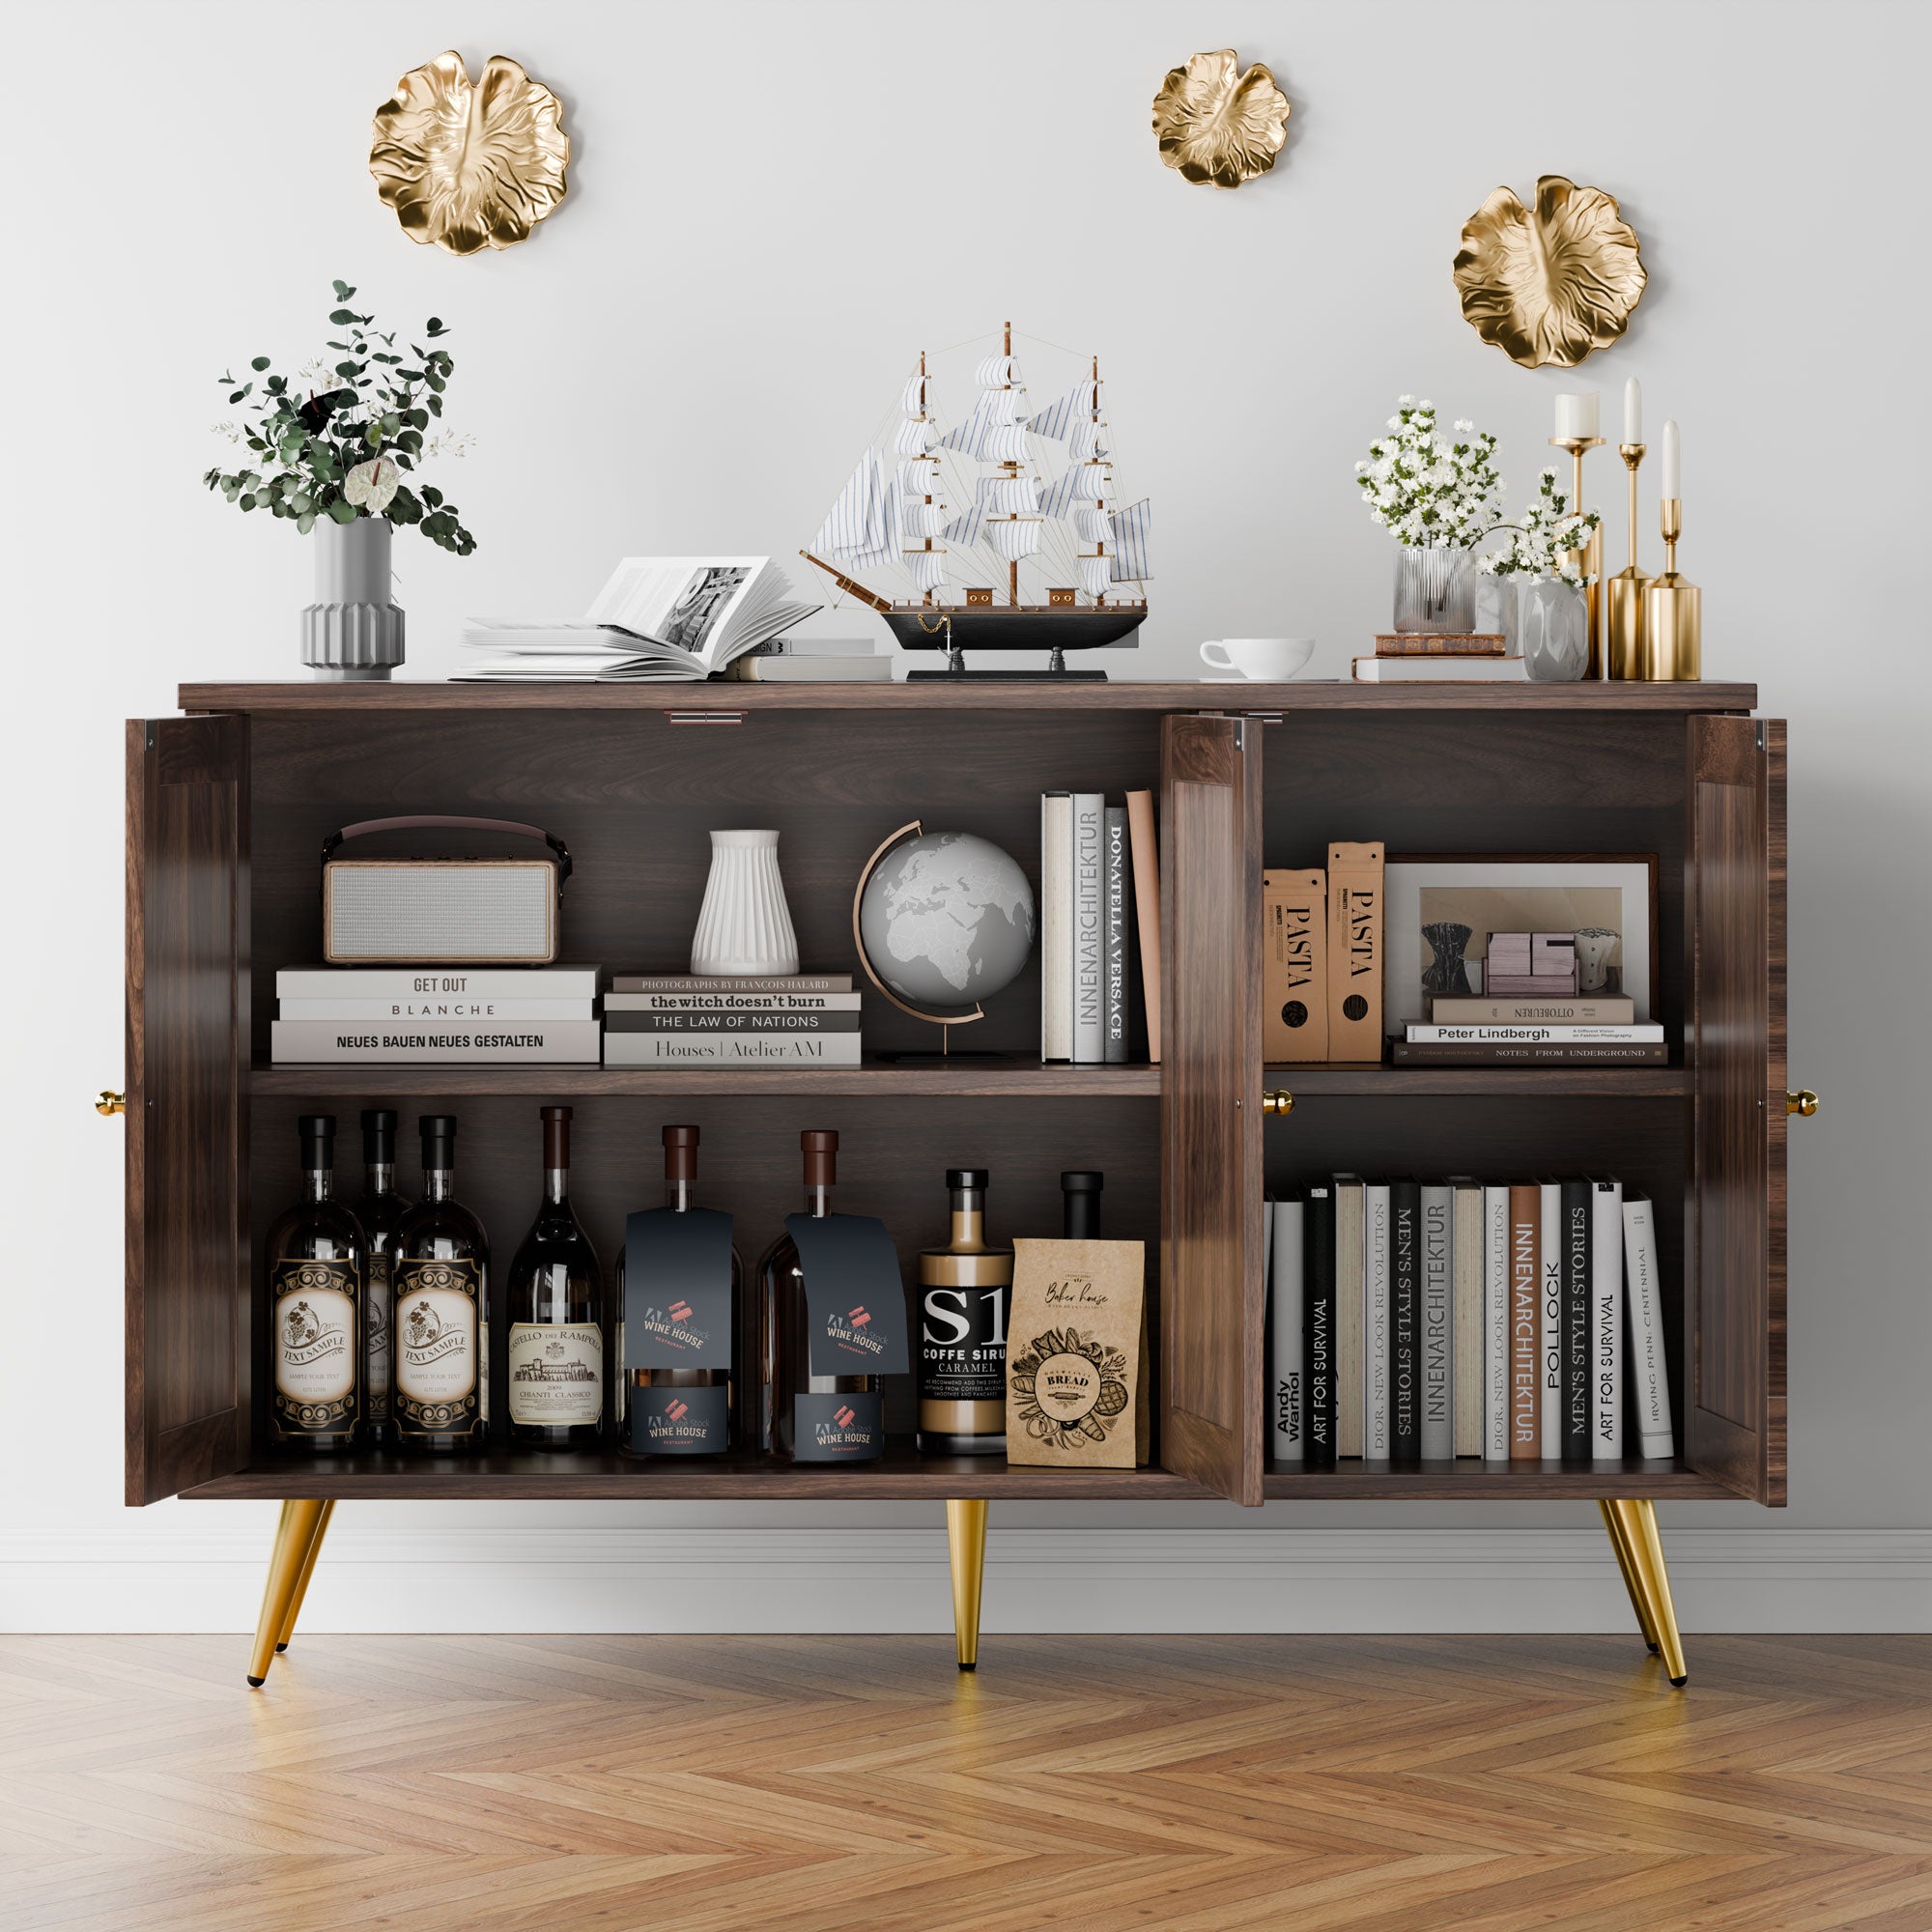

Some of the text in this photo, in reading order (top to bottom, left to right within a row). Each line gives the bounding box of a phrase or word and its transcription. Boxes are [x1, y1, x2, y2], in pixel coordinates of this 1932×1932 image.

[1080, 811, 1097, 1025] INNENARCHITEKTUR
[1111, 826, 1122, 1039] DONATELLA VERSACE
[1351, 891, 1374, 978] PASTA
[1287, 906, 1313, 990] PASTA
[413, 978, 468, 992] GET OUT
[641, 980, 829, 991] PHOTOGRAPHS BY FRANÇOIS HALARD
[651, 996, 676, 1008] the
[679, 996, 723, 1008] witch
[787, 996, 825, 1008] burn
[392, 1005, 495, 1015] BLANCHE
[653, 1016, 819, 1027] THE LAW OF NATIONS
[1515, 1008, 1575, 1018] OTTOBEUREN
[337, 1036, 543, 1048] NEUES BAUEN NEUES GESTALTEN
[657, 1041, 715, 1057] Houses
[728, 1041, 786, 1057] Atelier
[788, 1041, 822, 1057] AM
[1438, 1028, 1549, 1041] Peter Lindbergh
[1494, 1204, 1503, 1308] REVOLUTION
[1573, 1208, 1584, 1294] STORIES
[1638, 1246, 1652, 1327] CENTENNIAL
[1399, 1278, 1412, 1343] STYLE
[1428, 1206, 1445, 1422] INNENARCHITEKTUR
[1547, 1262, 1559, 1388] POLLOCK
[284, 1337, 345, 1361] TEXT SAMPLE
[406, 1337, 466, 1361] TEXT SAMPLE
[644, 1321, 703, 1349] WINE HOUSE
[827, 1327, 883, 1354] WINE HOUSE
[1494, 1315, 1503, 1359] LOOK
[1516, 1223, 1534, 1442] INNENARCHITEKTUR
[1573, 1300, 1584, 1365] STYLE
[923, 1349, 966, 1360] COFFE
[939, 1363, 995, 1372] CARAMEL
[1314, 1298, 1326, 1443] ART FOR SURVIVAL
[1601, 1294, 1613, 1441] ART FOR SURVIVAL
[1047, 1376, 1090, 1387] BREAD
[1399, 1349, 1412, 1435] STORIES
[1494, 1366, 1503, 1401] NEW
[1649, 1374, 1660, 1422] IRVING
[1277, 1379, 1291, 1434] Andy
[1289, 1372, 1299, 1442] Warhol
[649, 1428, 707, 1437] WINE HOUSE
[817, 1434, 870, 1445] WINE HOUSE
